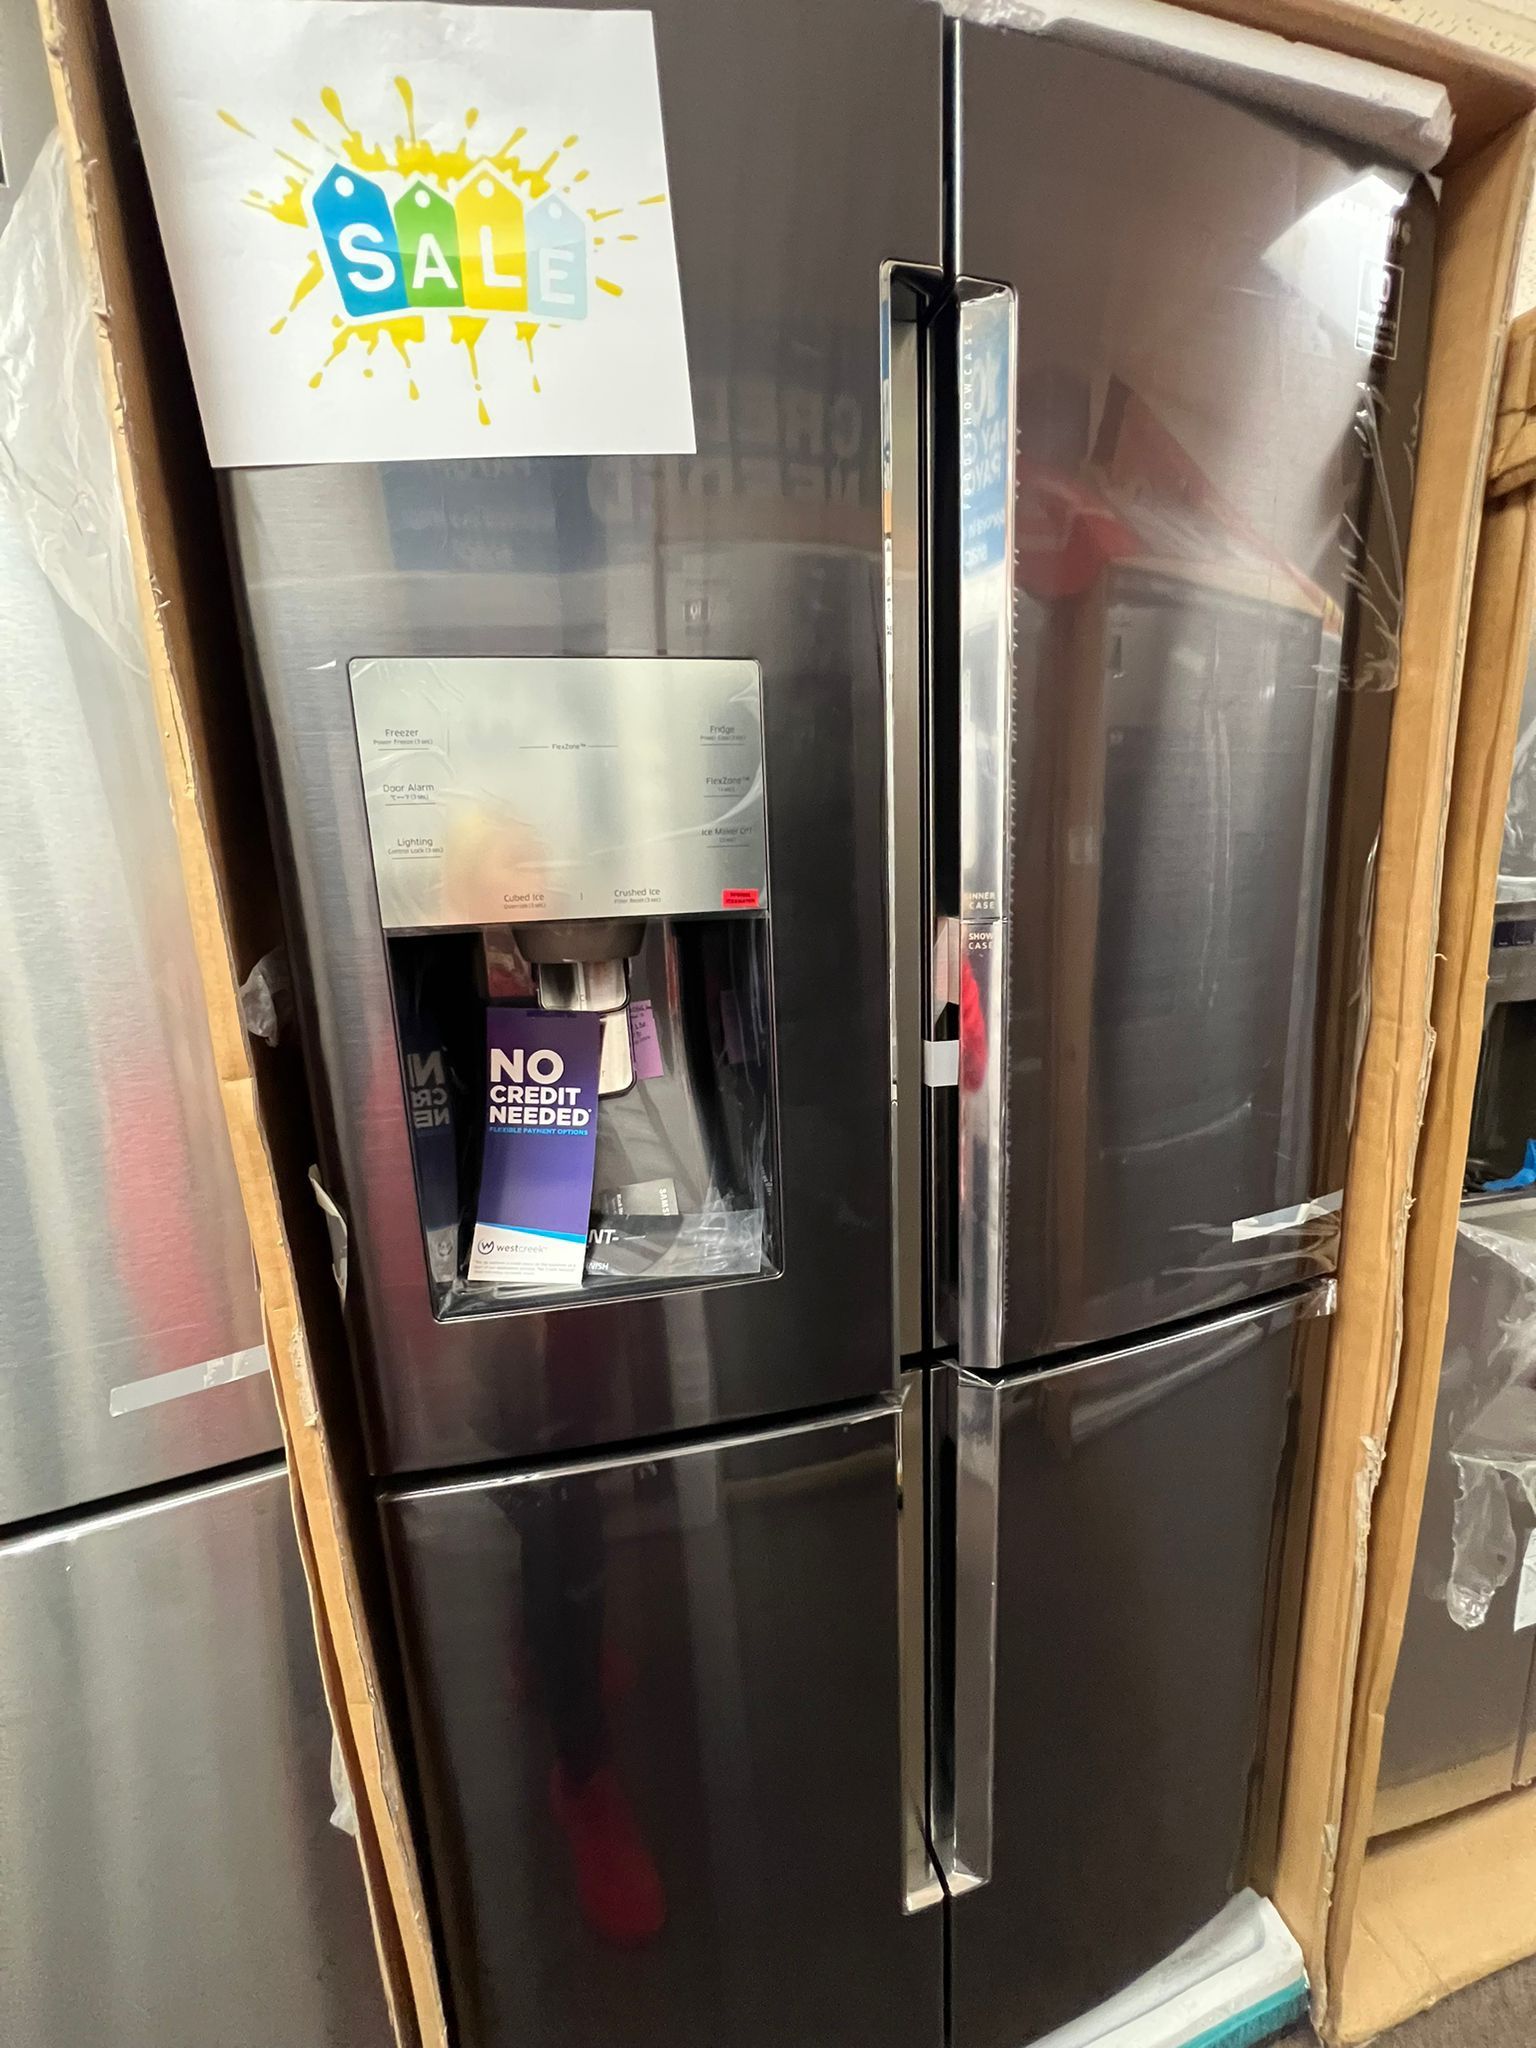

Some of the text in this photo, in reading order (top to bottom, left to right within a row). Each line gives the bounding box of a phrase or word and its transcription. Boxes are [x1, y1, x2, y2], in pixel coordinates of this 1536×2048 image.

[337, 222, 575, 305] SALE
[963, 457, 973, 509] FOOD
[385, 728, 419, 737] Freezer
[710, 725, 735, 735] Fridge
[383, 783, 435, 793] Door Alarm
[701, 829, 713, 837] Ice
[397, 838, 433, 848] Lighting
[614, 887, 661, 898] Crushed Ice
[969, 891, 996, 900] INNER
[504, 893, 545, 903] Cubed Ice
[969, 901, 995, 910] CASE
[968, 932, 993, 941] SHOW
[490, 1048, 565, 1085] NO
[489, 1085, 582, 1106] CREDIT
[489, 1126, 522, 1134] FLEXIBLE
[557, 1128, 588, 1136] OPTIONS
[496, 1244, 544, 1254] westcreek
